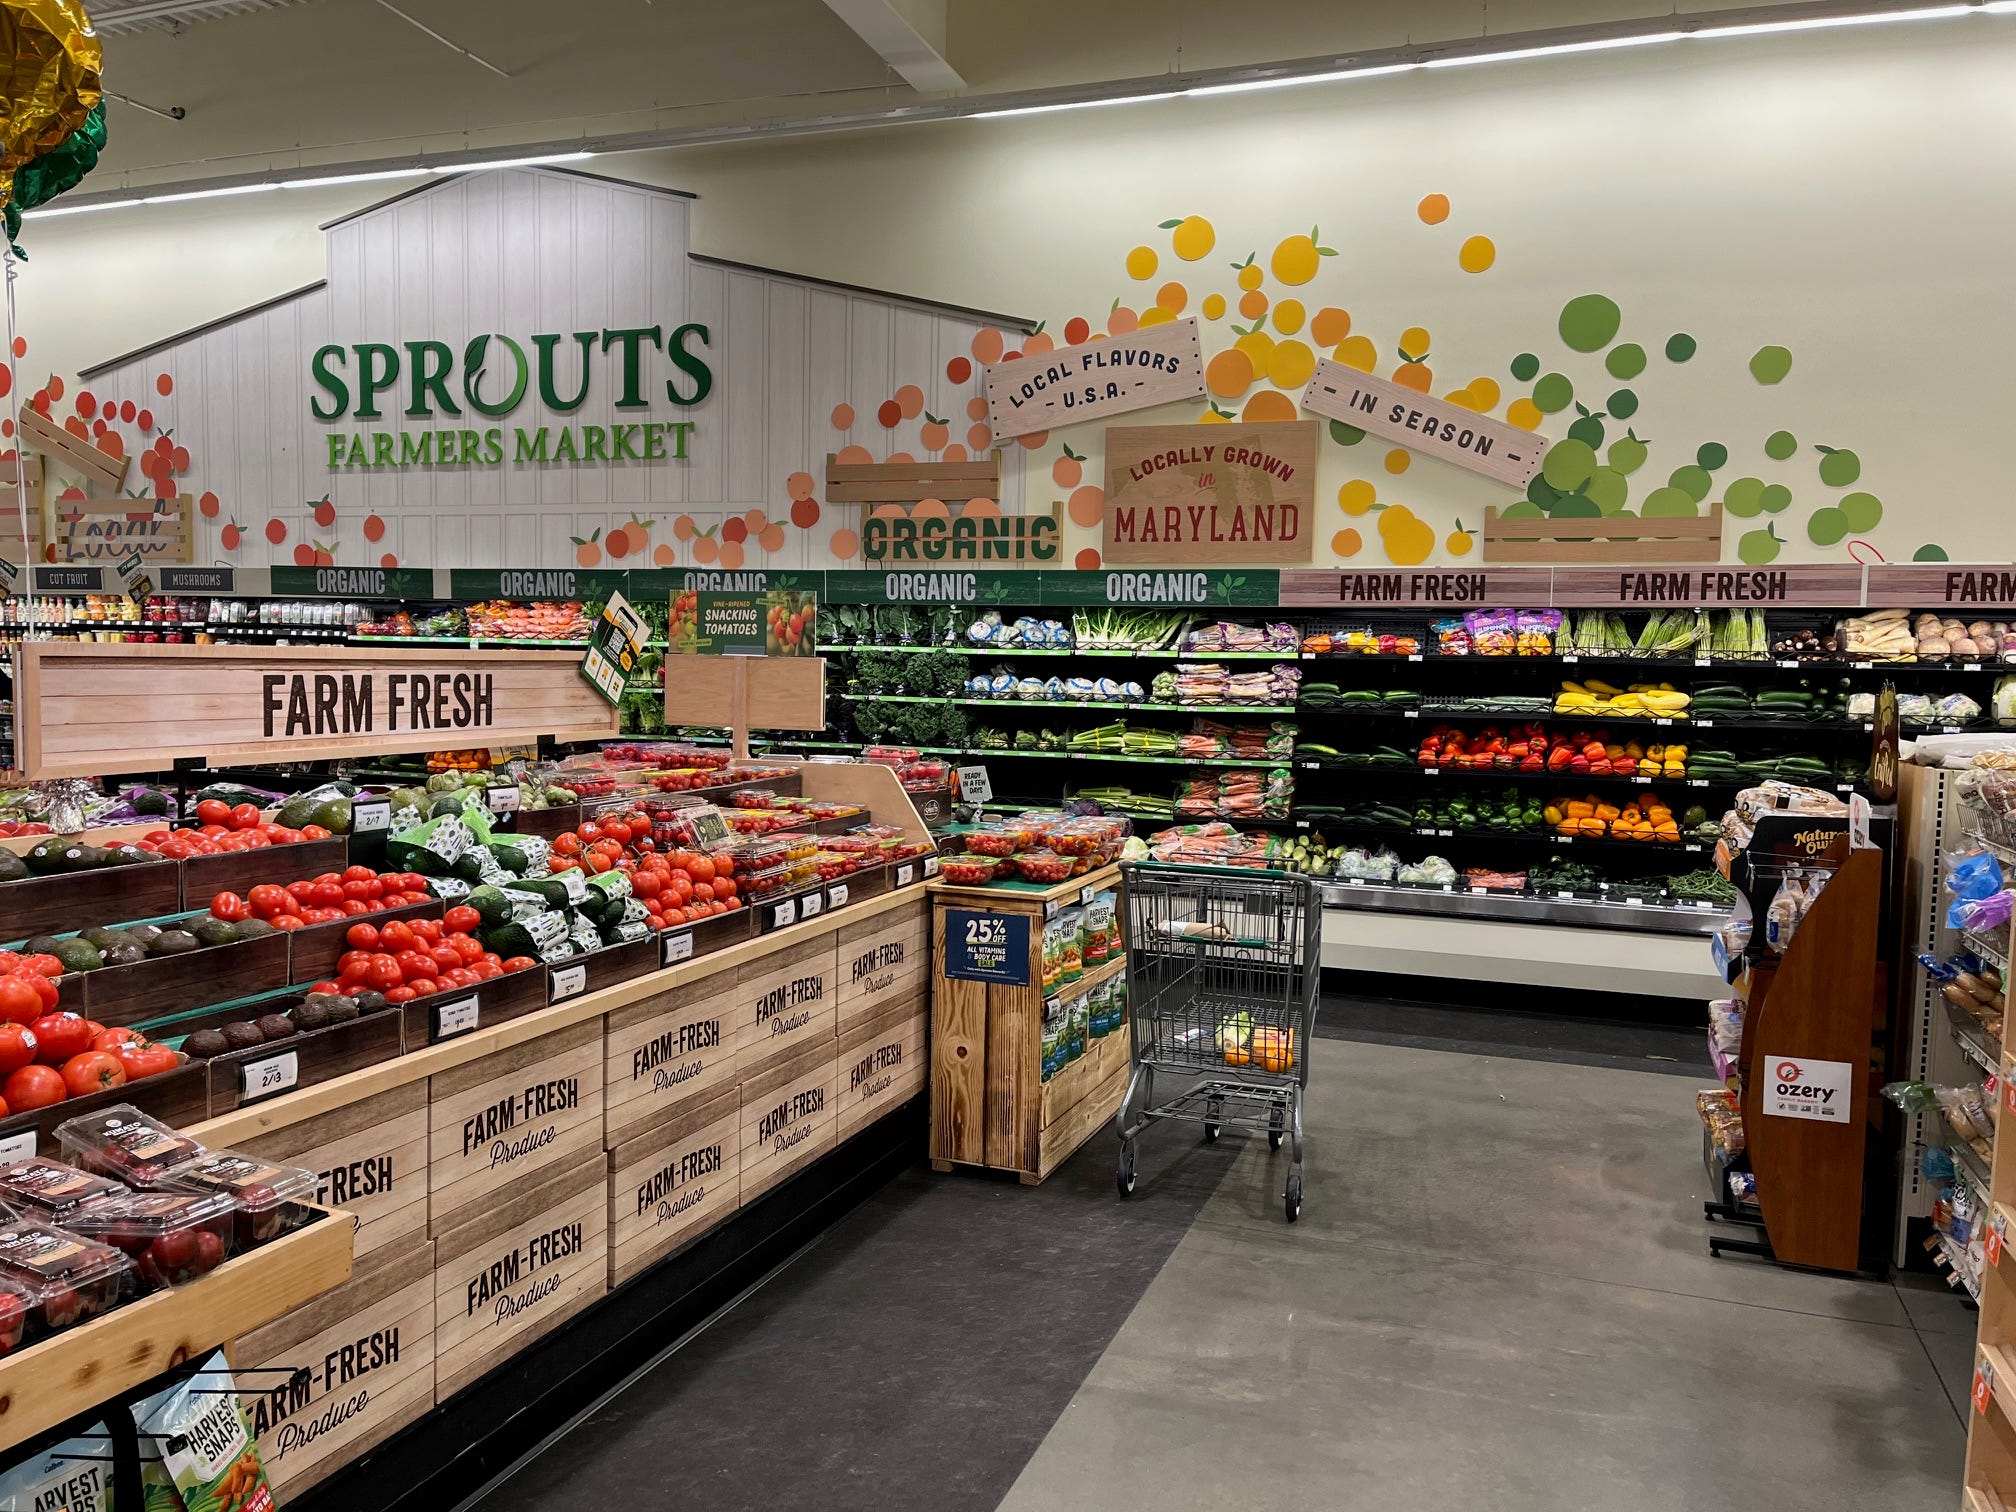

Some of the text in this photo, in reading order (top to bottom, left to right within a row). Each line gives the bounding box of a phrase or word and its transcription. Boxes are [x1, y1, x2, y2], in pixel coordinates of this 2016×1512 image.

[310, 324, 712, 419] SPROUTS
[1009, 349, 1181, 410] LOCAL FLAVORS
[1349, 389, 1494, 457] IN SEASON
[326, 421, 695, 469] FARMERS MARKET
[1129, 445, 1295, 483] LOCALLY GROWN
[1197, 471, 1216, 490] in
[66, 498, 167, 559] Local
[863, 516, 1057, 560] ORGANIC
[1114, 504, 1299, 543] MARYLAND
[49, 573, 88, 586] CUT FRUIT
[172, 574, 221, 586] MUSHROOMS
[316, 567, 386, 594] ORGANIC
[500, 571, 576, 599] ORGANIC
[684, 571, 767, 591] ORGANIC
[885, 573, 976, 600] ORGANIC
[1106, 573, 1207, 602] ORGANIC
[1339, 574, 1486, 602] FARM FRESH
[1620, 571, 1787, 601] FARM FRESH
[1945, 572, 2016, 602] FARM
[704, 623, 757, 635] TOMATOES
[705, 609, 757, 621] SNACKING
[262, 673, 494, 737] FARM FRESH
[969, 786, 983, 794] DAYS
[965, 919, 1006, 943] 25%
[992, 935, 1007, 943] OFF
[852, 943, 905, 985] FARM-FRESH
[979, 946, 1006, 954] VITAMINS
[991, 954, 1006, 962] CARE
[756, 976, 823, 1027] FARM-FRESH
[864, 972, 894, 996] Produce
[771, 1010, 810, 1039] Produce
[633, 1020, 720, 1081] FARM-FRESH
[851, 1042, 902, 1093] FARM-FRESH
[654, 1058, 703, 1094] Produce
[862, 1073, 891, 1102] Produce
[1776, 1083, 1834, 1104] ozery
[102, 1121, 142, 1137] KUMATO
[463, 1078, 578, 1157] FARM-FRESH
[758, 1088, 824, 1147] FARM-FRESH
[490, 1123, 556, 1170] Produce
[774, 1123, 811, 1156] Produce
[316, 1156, 392, 1206] FRESH
[637, 1145, 721, 1216] FARM-FRESH
[657, 1186, 704, 1226] Produce
[468, 1223, 583, 1317] FARM-FRESH
[495, 1273, 561, 1326] Produce
[185, 1393, 234, 1455] HARVEST
[204, 1416, 240, 1463] SNAPS
[278, 1390, 369, 1460] Produce
[43, 1460, 64, 1474] Calbee
[34, 1466, 100, 1512] ARVEST
